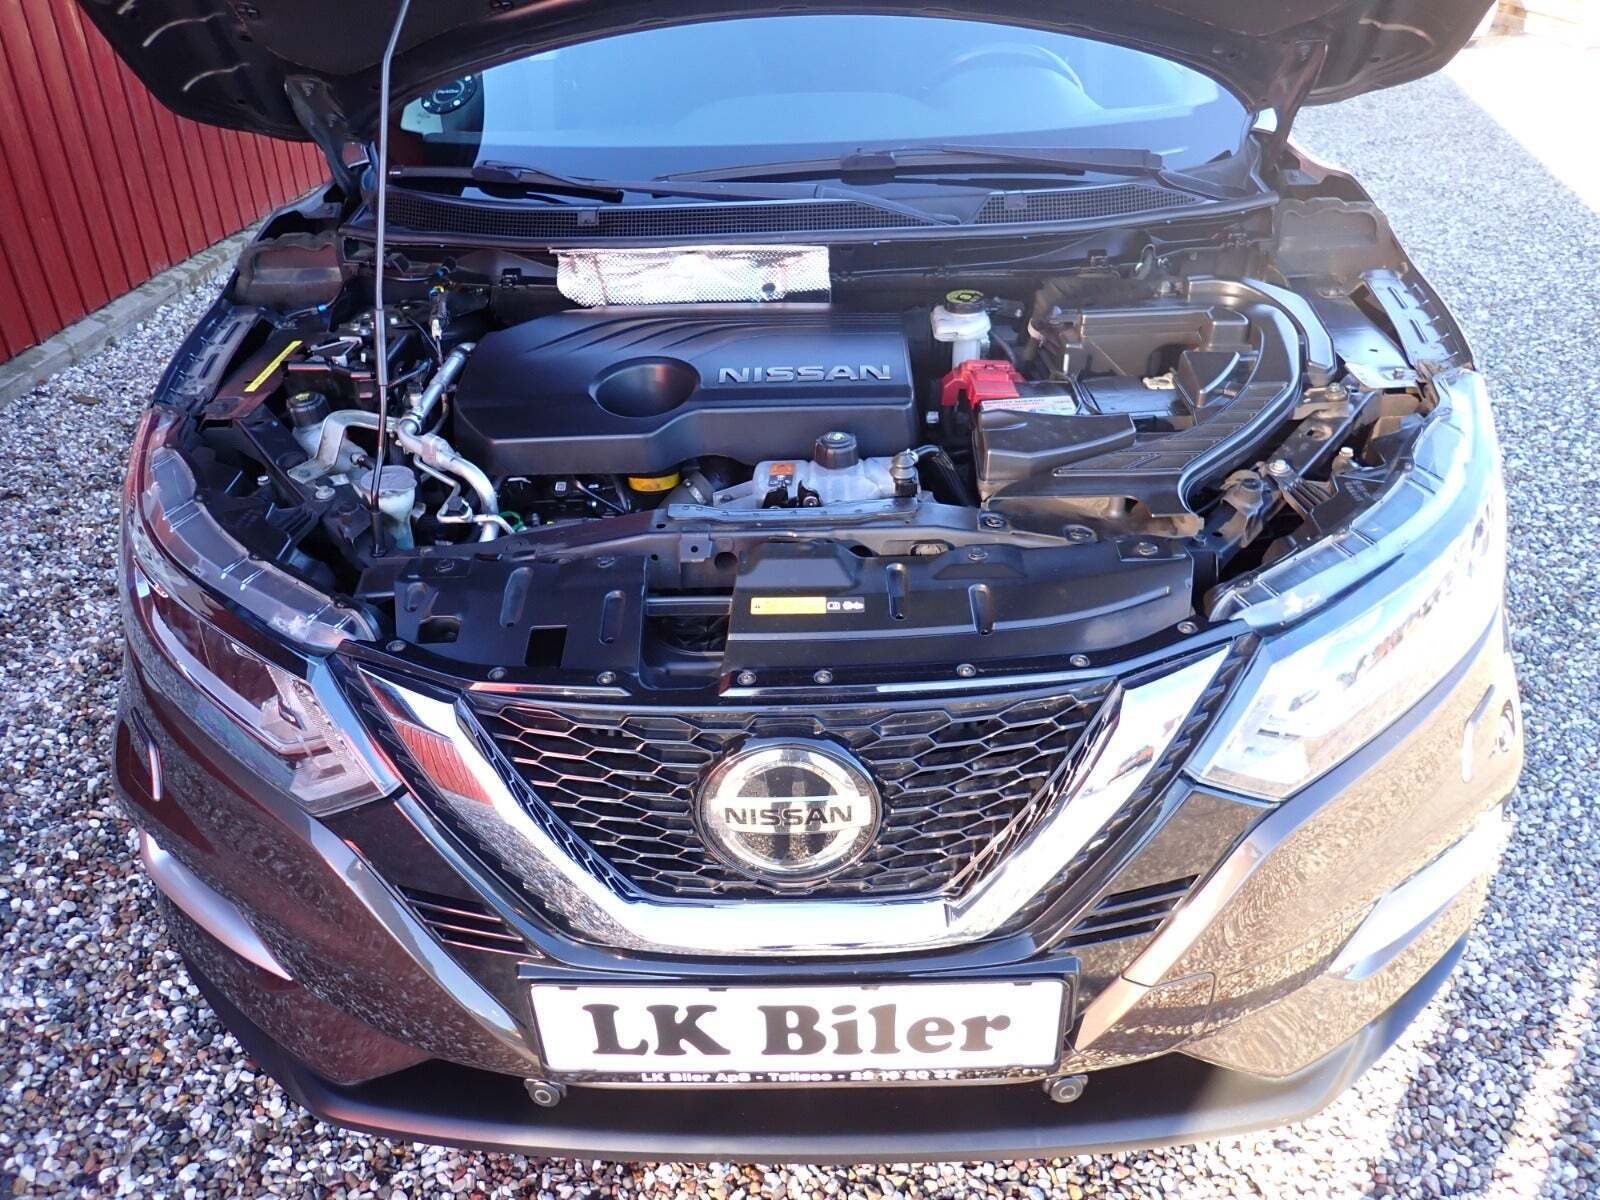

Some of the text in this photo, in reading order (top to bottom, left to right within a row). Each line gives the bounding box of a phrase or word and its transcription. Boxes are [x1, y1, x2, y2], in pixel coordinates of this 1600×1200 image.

[718, 364, 892, 383] NISSAN
[724, 806, 851, 826] NISSAN
[582, 1003, 1011, 1056] LK Biler
[641, 1072, 665, 1082] LK
[669, 1072, 711, 1082] Biler
